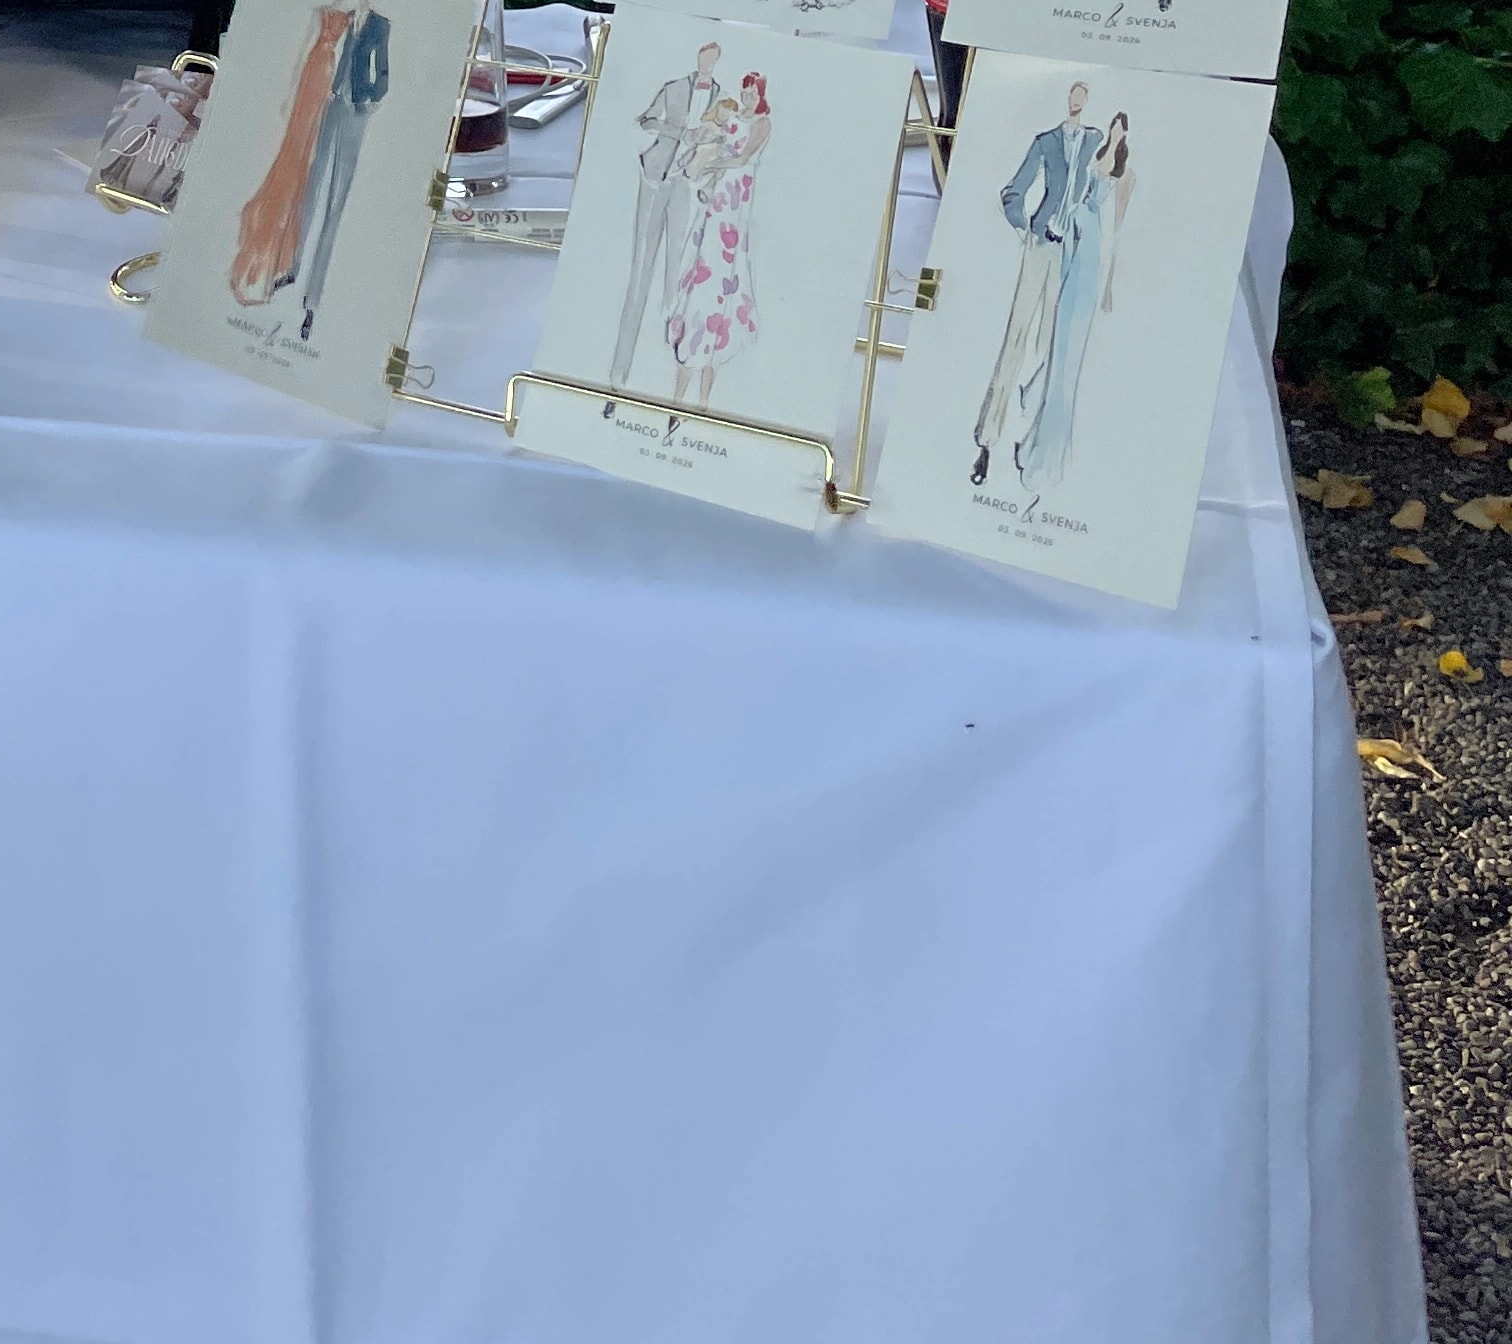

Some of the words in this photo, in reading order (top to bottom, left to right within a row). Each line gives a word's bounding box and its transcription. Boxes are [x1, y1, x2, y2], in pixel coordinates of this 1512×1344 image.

[1052, 8, 1102, 22] MARCO
[1104, 2, 1124, 28] &
[1126, 16, 1177, 29] SVENJA
[615, 419, 659, 438] MARCO
[662, 420, 680, 447] &
[681, 436, 728, 458] SVENJA
[972, 493, 1018, 514] MARCO
[1020, 494, 1041, 524] &
[1040, 511, 1088, 534] SVENJA
